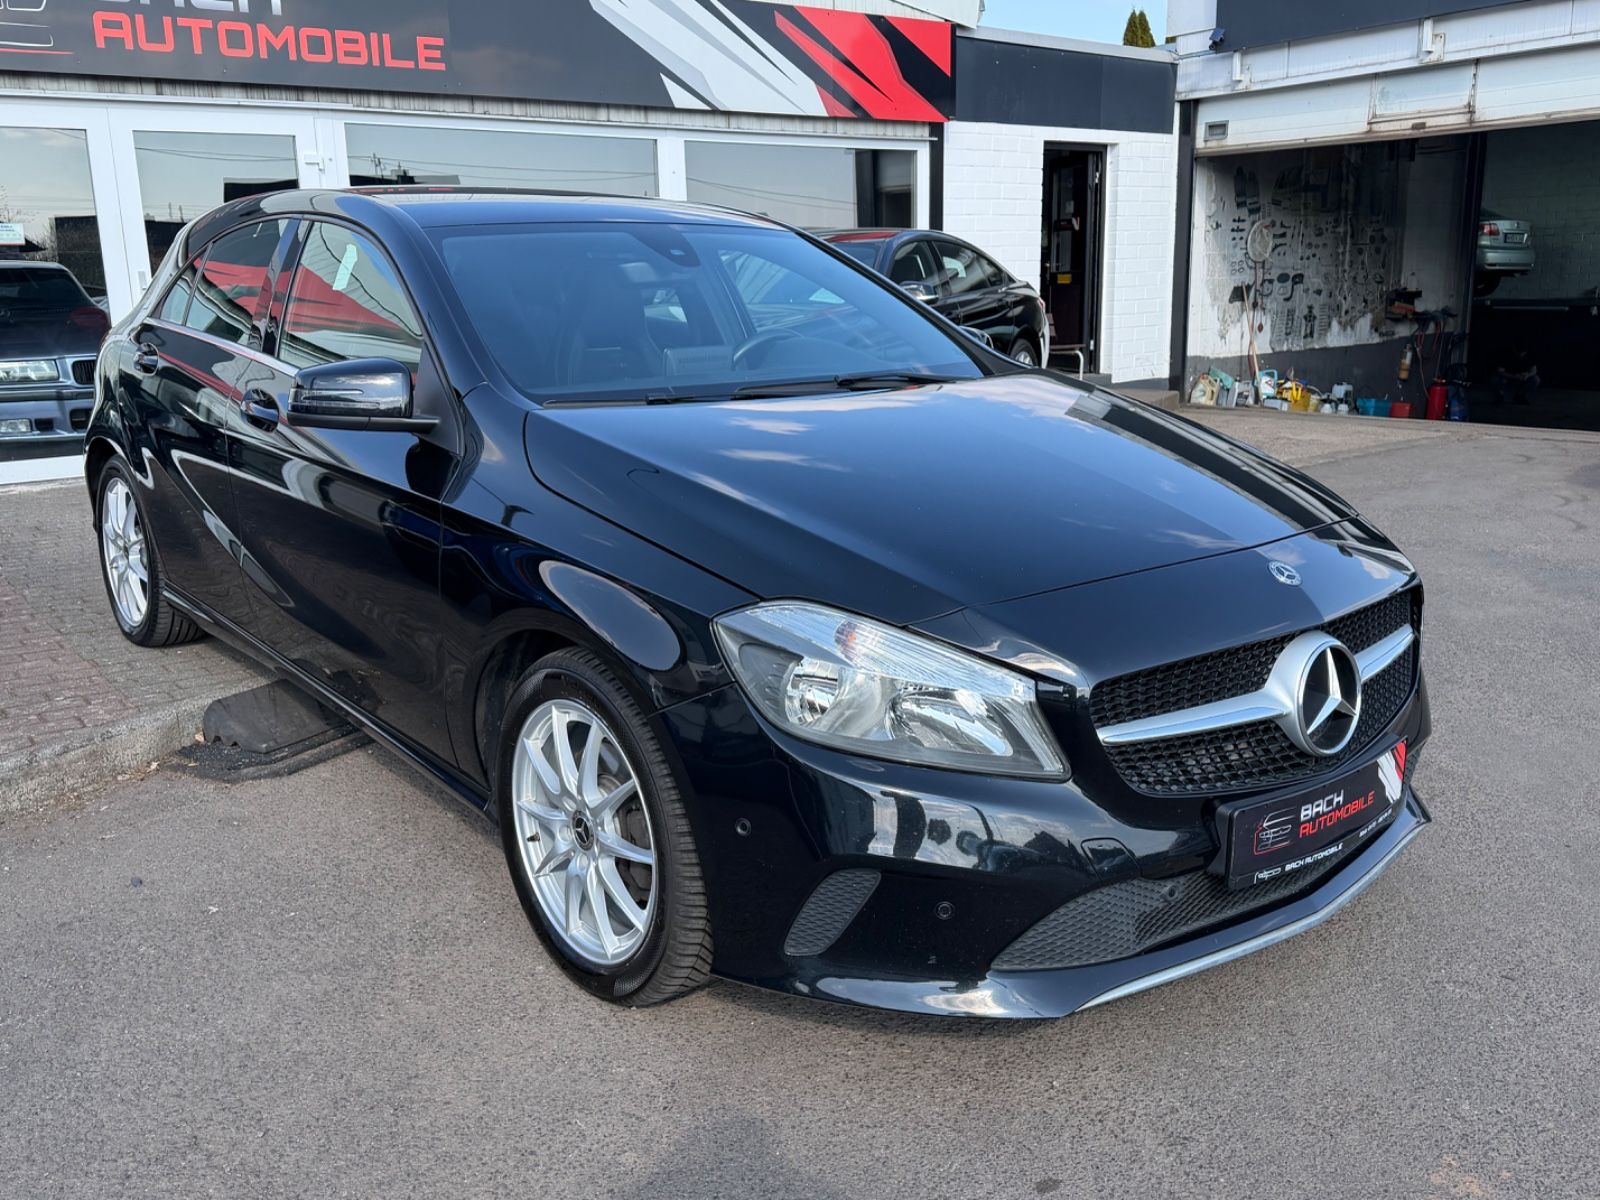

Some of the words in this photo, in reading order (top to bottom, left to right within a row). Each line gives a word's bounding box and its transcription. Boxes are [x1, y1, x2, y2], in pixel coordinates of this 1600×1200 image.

[92, 11, 446, 71] AUTOMOBILE
[1299, 790, 1375, 838] AUTOMOBILE
[1300, 789, 1344, 822] BACH
[1285, 859, 1304, 872] BACH
[1304, 842, 1344, 864] AUTOMOBILE
